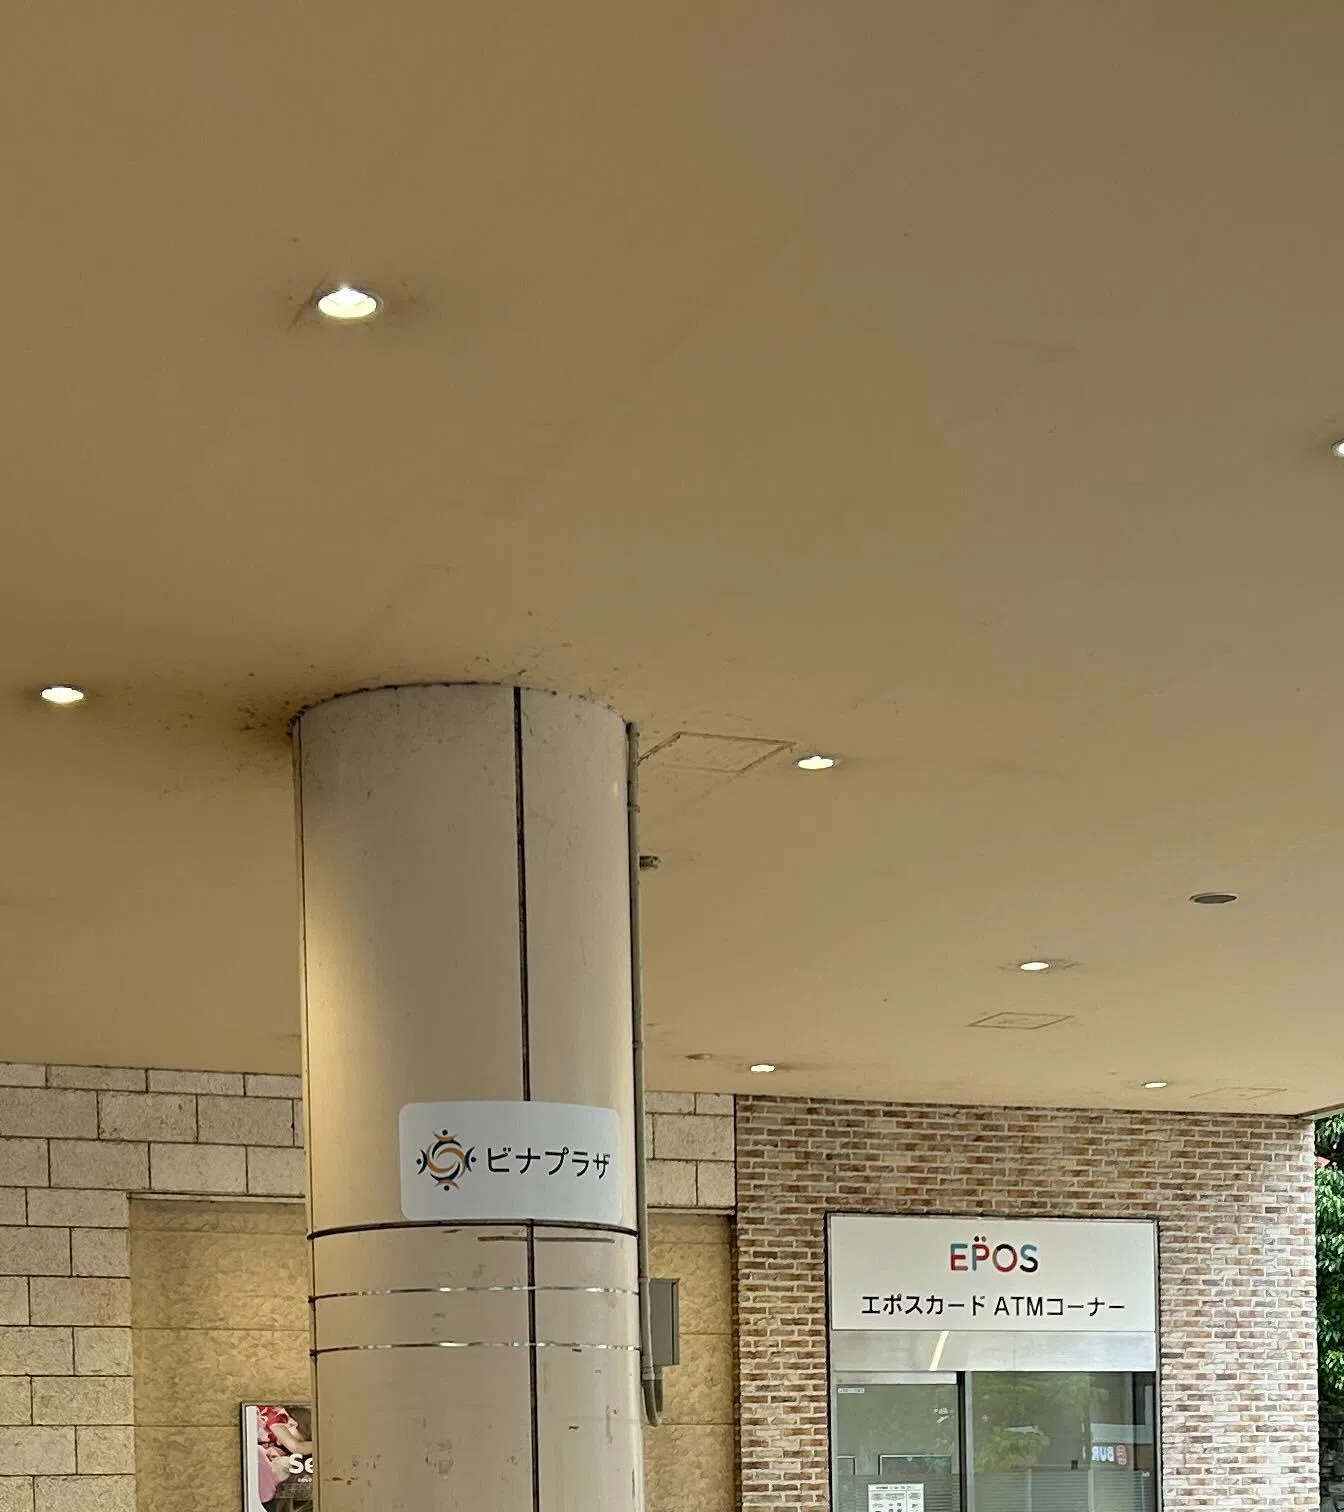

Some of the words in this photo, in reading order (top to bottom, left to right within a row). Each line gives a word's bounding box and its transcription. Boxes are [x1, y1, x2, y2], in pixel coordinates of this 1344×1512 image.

[487, 1147, 610, 1179] ビナプラザ
[949, 1236, 1040, 1273] EPOS
[861, 1294, 985, 1316] エポスカード
[994, 1295, 1126, 1317] ATMコーナー
